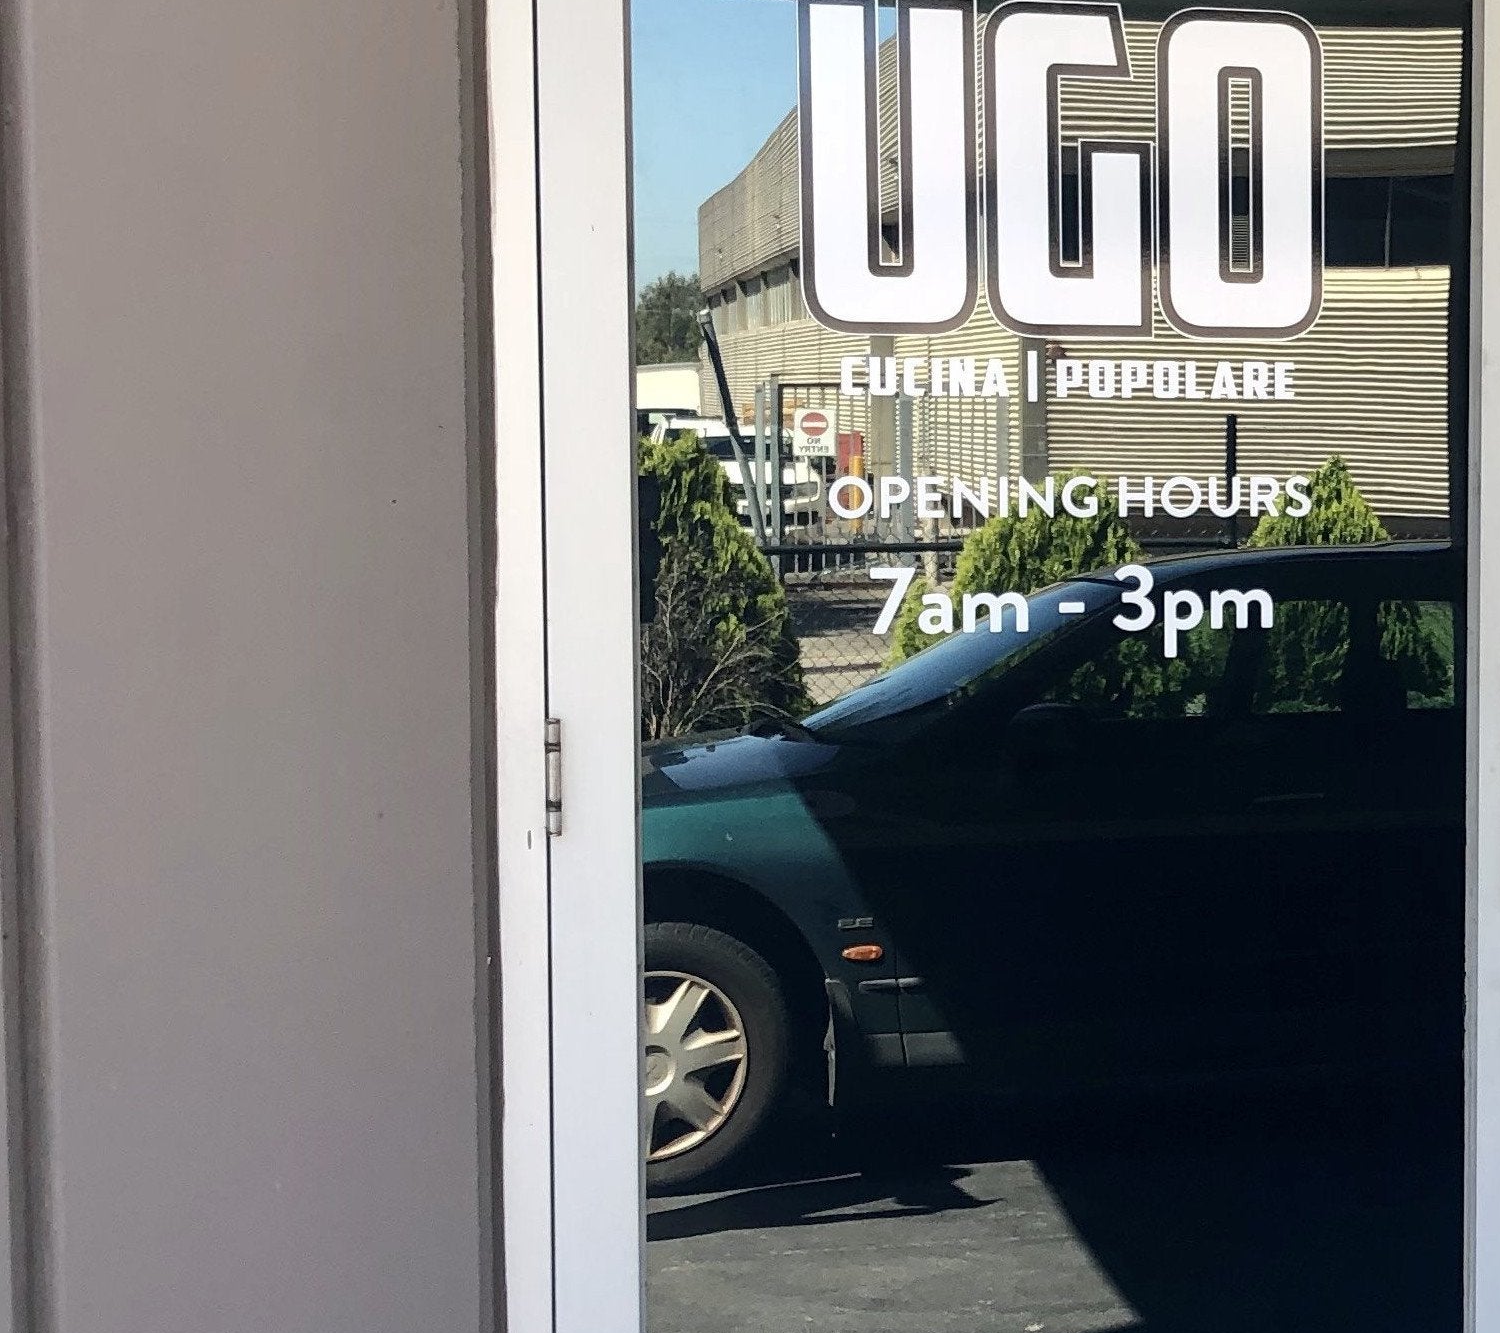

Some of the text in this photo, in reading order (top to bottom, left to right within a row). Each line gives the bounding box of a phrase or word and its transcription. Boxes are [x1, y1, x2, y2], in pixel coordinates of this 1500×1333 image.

[841, 355, 1296, 400] CUCINA POPOLARE
[829, 476, 1312, 520] OPENING HOURS
[871, 567, 1027, 636] 7am
[1112, 565, 1274, 658] 3pm
